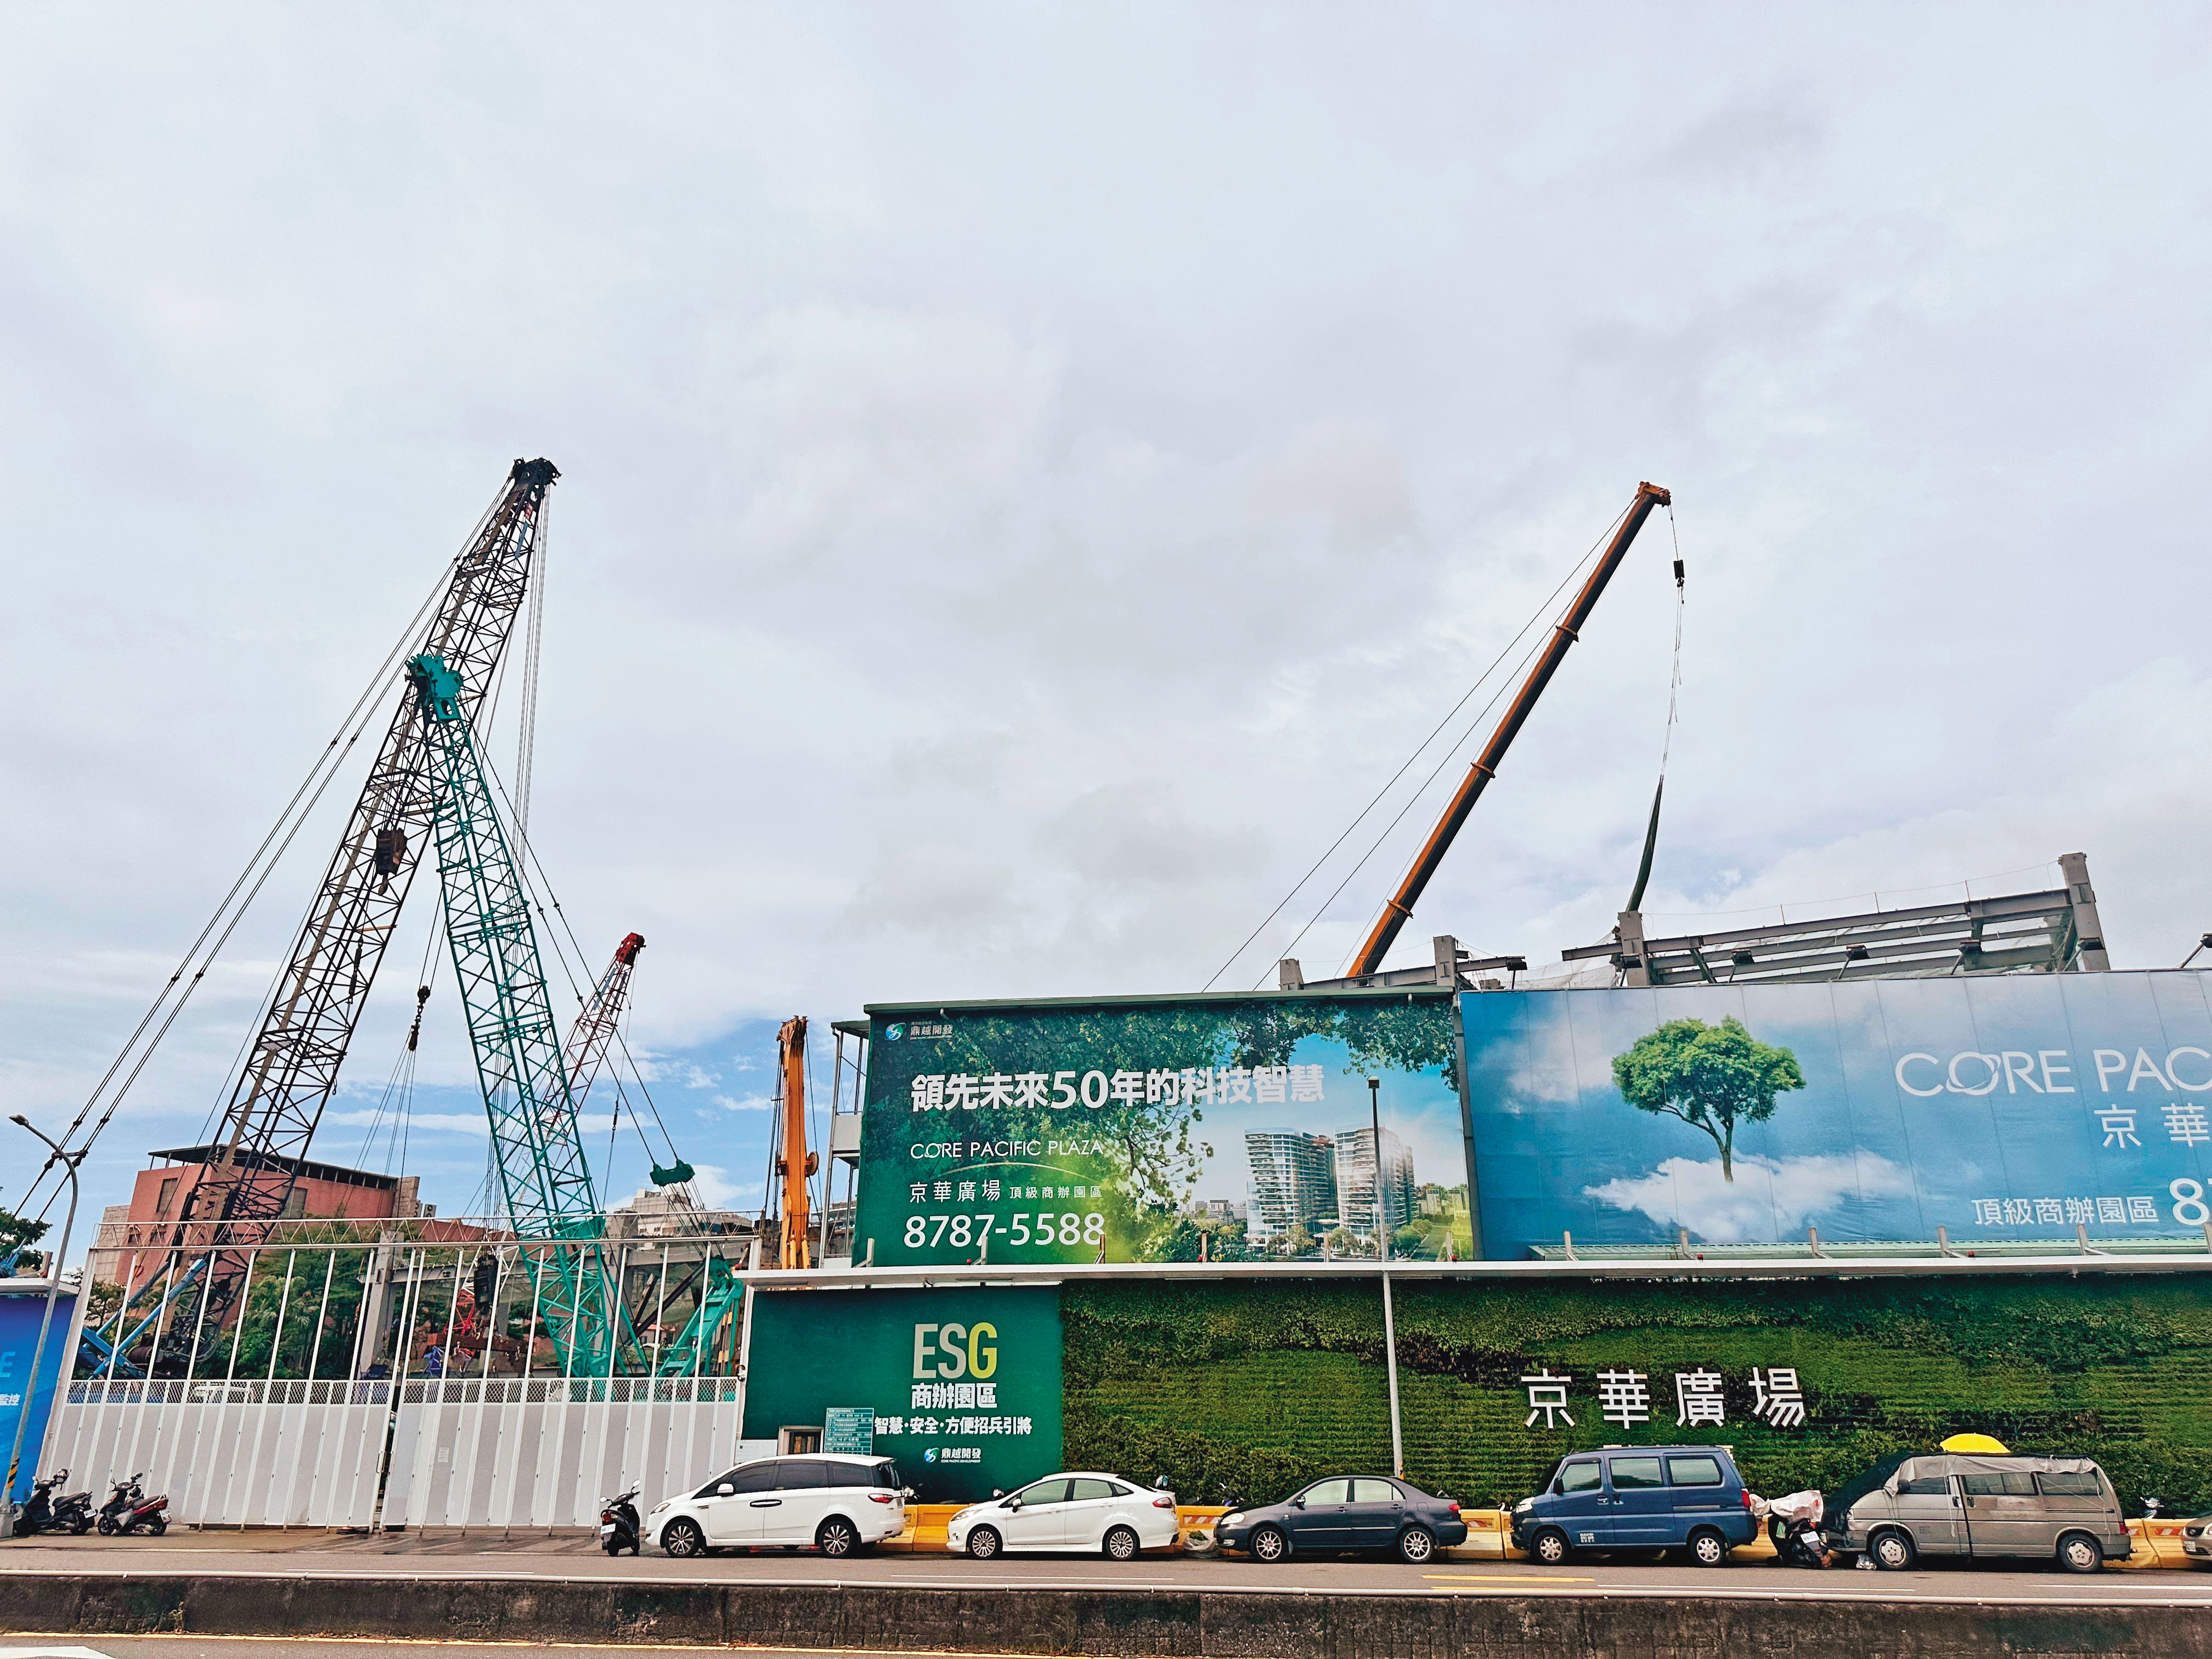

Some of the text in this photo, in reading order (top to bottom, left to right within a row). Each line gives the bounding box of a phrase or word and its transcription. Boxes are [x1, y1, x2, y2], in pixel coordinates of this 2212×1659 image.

[911, 1024, 953, 1036] 鼎越開發
[910, 1064, 1325, 1113] 領先未來50年的科技智慧
[1894, 1050, 2075, 1097] CORE
[2094, 1103, 2210, 1148] 京華
[910, 1138, 1103, 1160] CORE PACIFIC PLAZA
[909, 1180, 1102, 1204] 京華廣場 頂級商辦園區
[2169, 1178, 2212, 1226] 8
[1972, 1195, 2159, 1226] 頂級商辦園區
[904, 1213, 1105, 1248] 8787-5588
[913, 1322, 997, 1379] ESG
[911, 1383, 997, 1409] 商辦園區
[1521, 1367, 1804, 1430] 京華廣場
[941, 1448, 981, 1459] 鼎越開發
